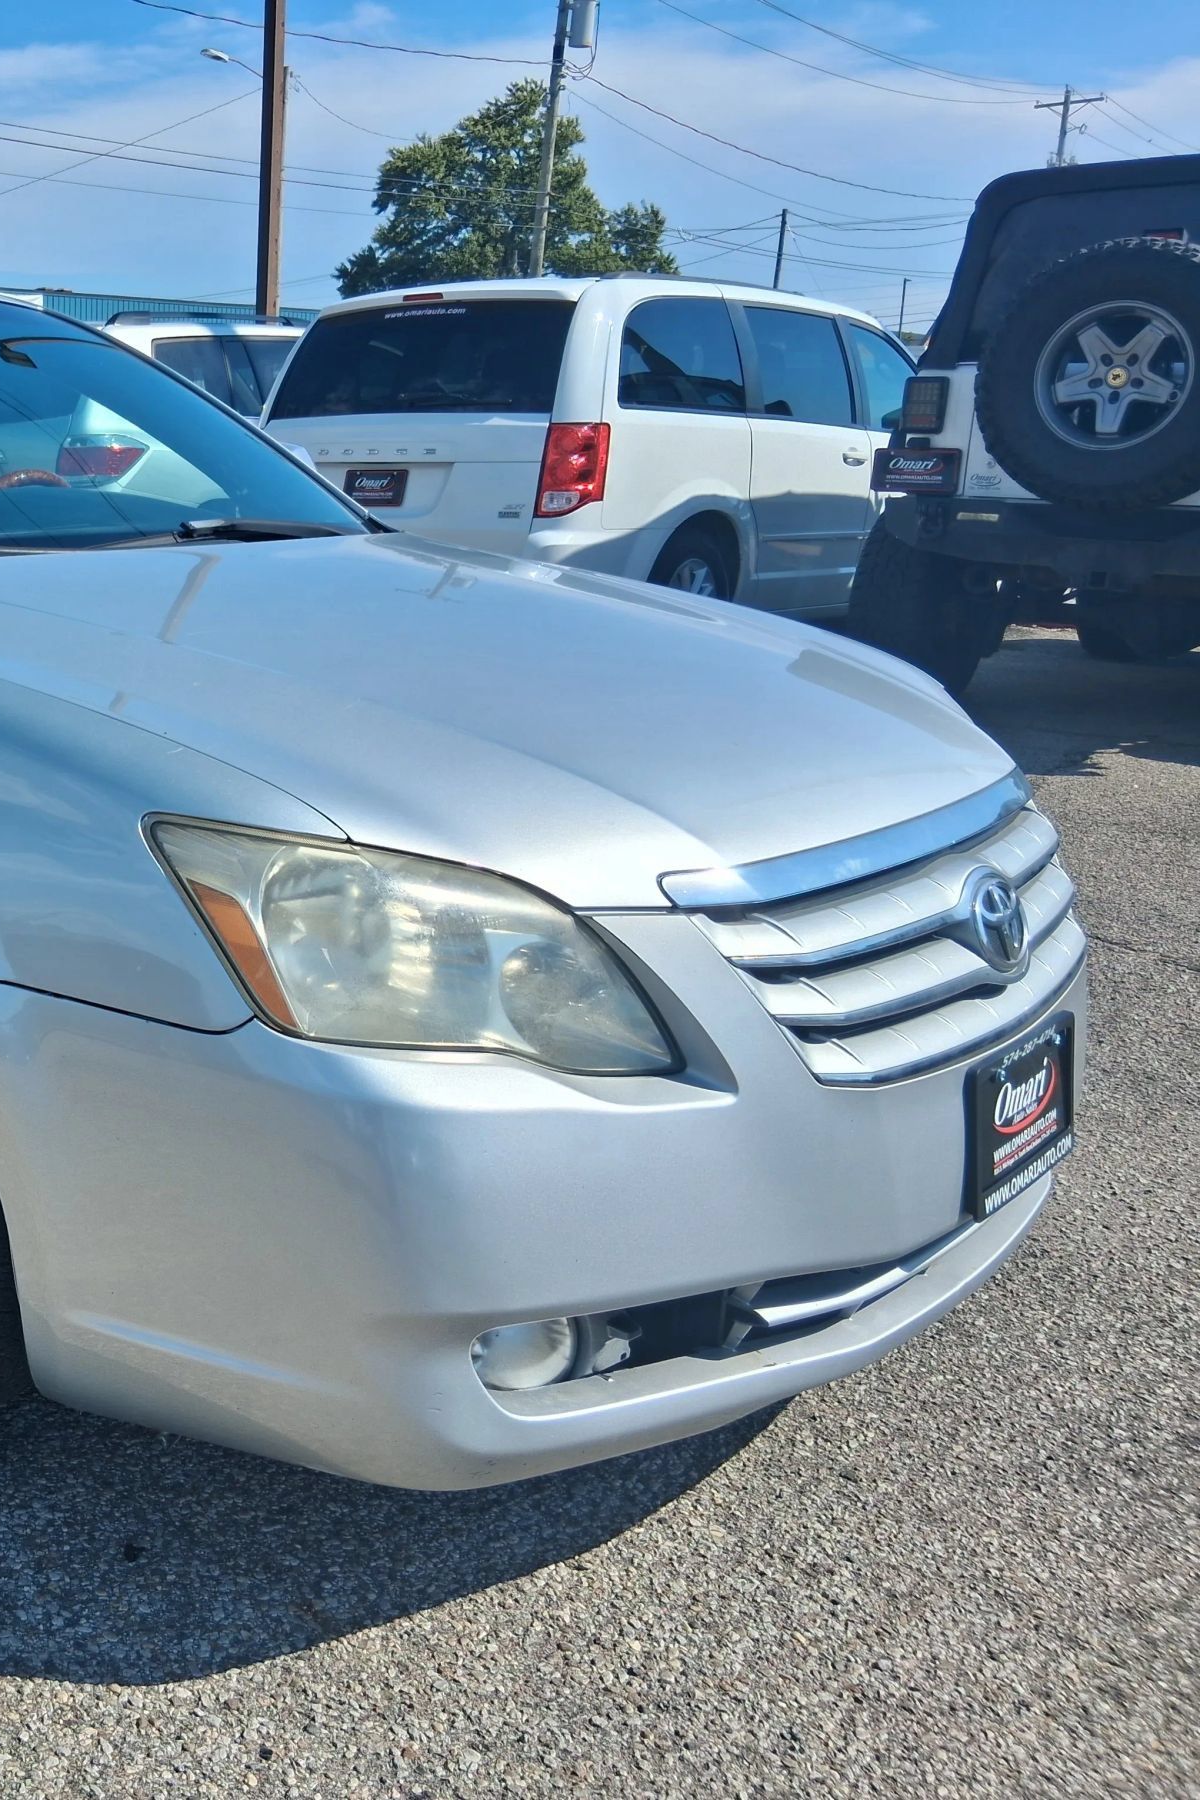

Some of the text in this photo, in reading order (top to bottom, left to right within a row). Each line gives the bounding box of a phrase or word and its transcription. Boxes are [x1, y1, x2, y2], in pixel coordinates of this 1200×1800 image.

[384, 307, 466, 319] www.omariauto.com
[889, 457, 937, 470] Omari
[355, 476, 391, 488] Omari
[994, 1056, 1048, 1126] Omari
[993, 1107, 1057, 1163] WWW.OMARIAUTO.COM
[984, 1133, 1072, 1215] WWW.OMARIAUTO.COM
